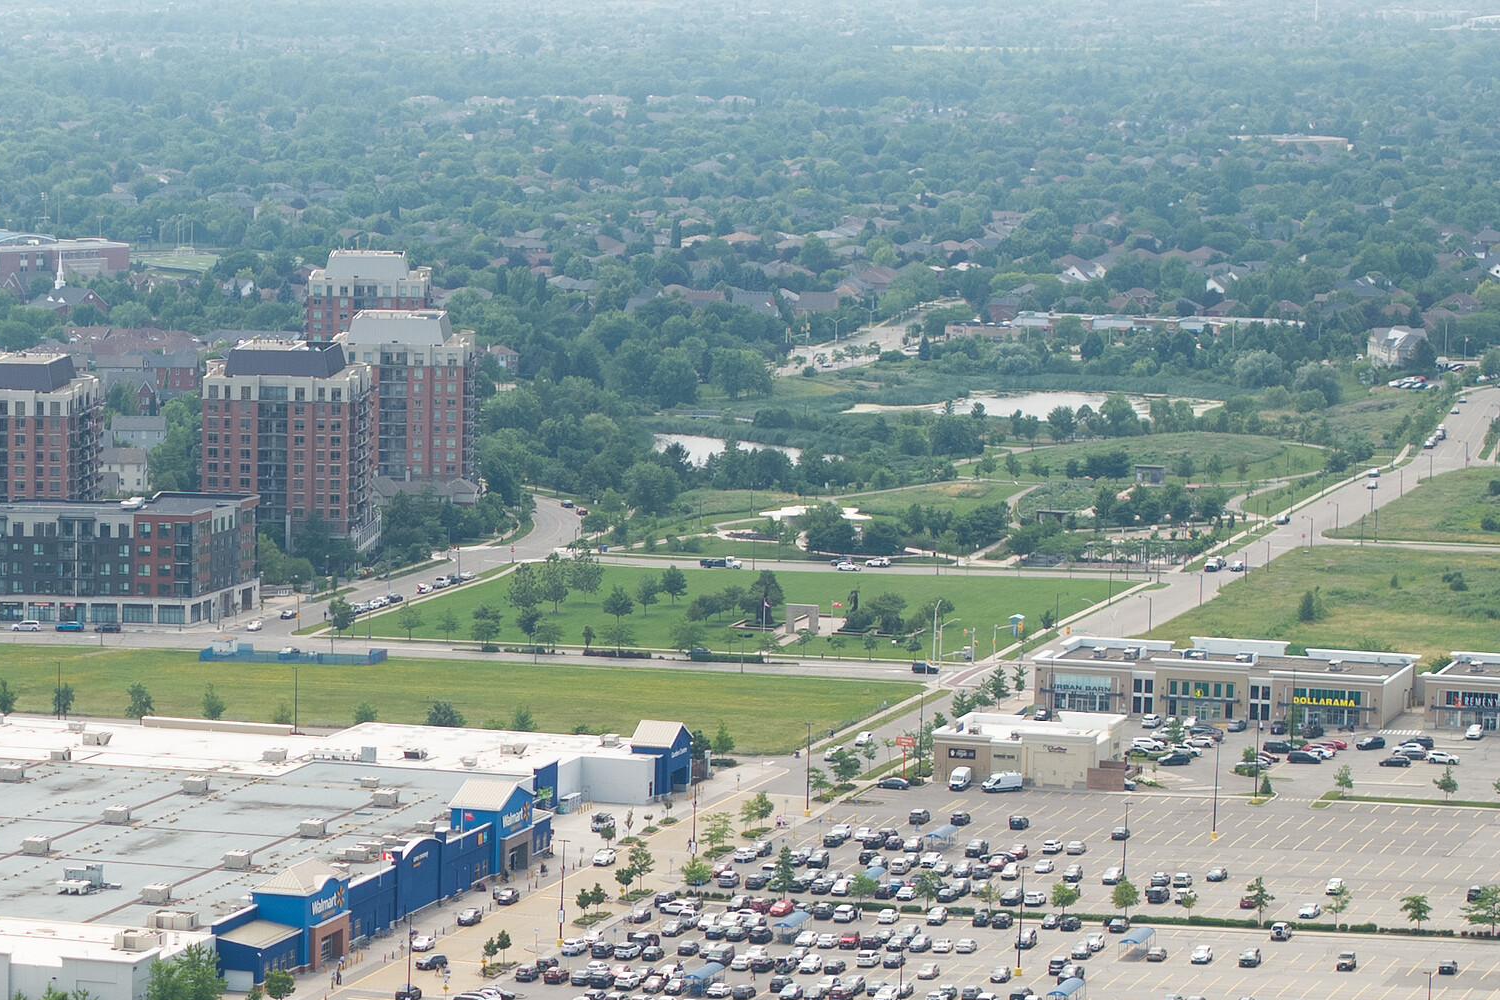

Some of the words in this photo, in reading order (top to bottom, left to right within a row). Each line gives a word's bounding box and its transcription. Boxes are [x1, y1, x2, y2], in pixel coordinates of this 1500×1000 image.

[1293, 696, 1356, 707] DOLLARAMA
[502, 807, 524, 829] Walmart
[311, 892, 337, 916] Walmart
